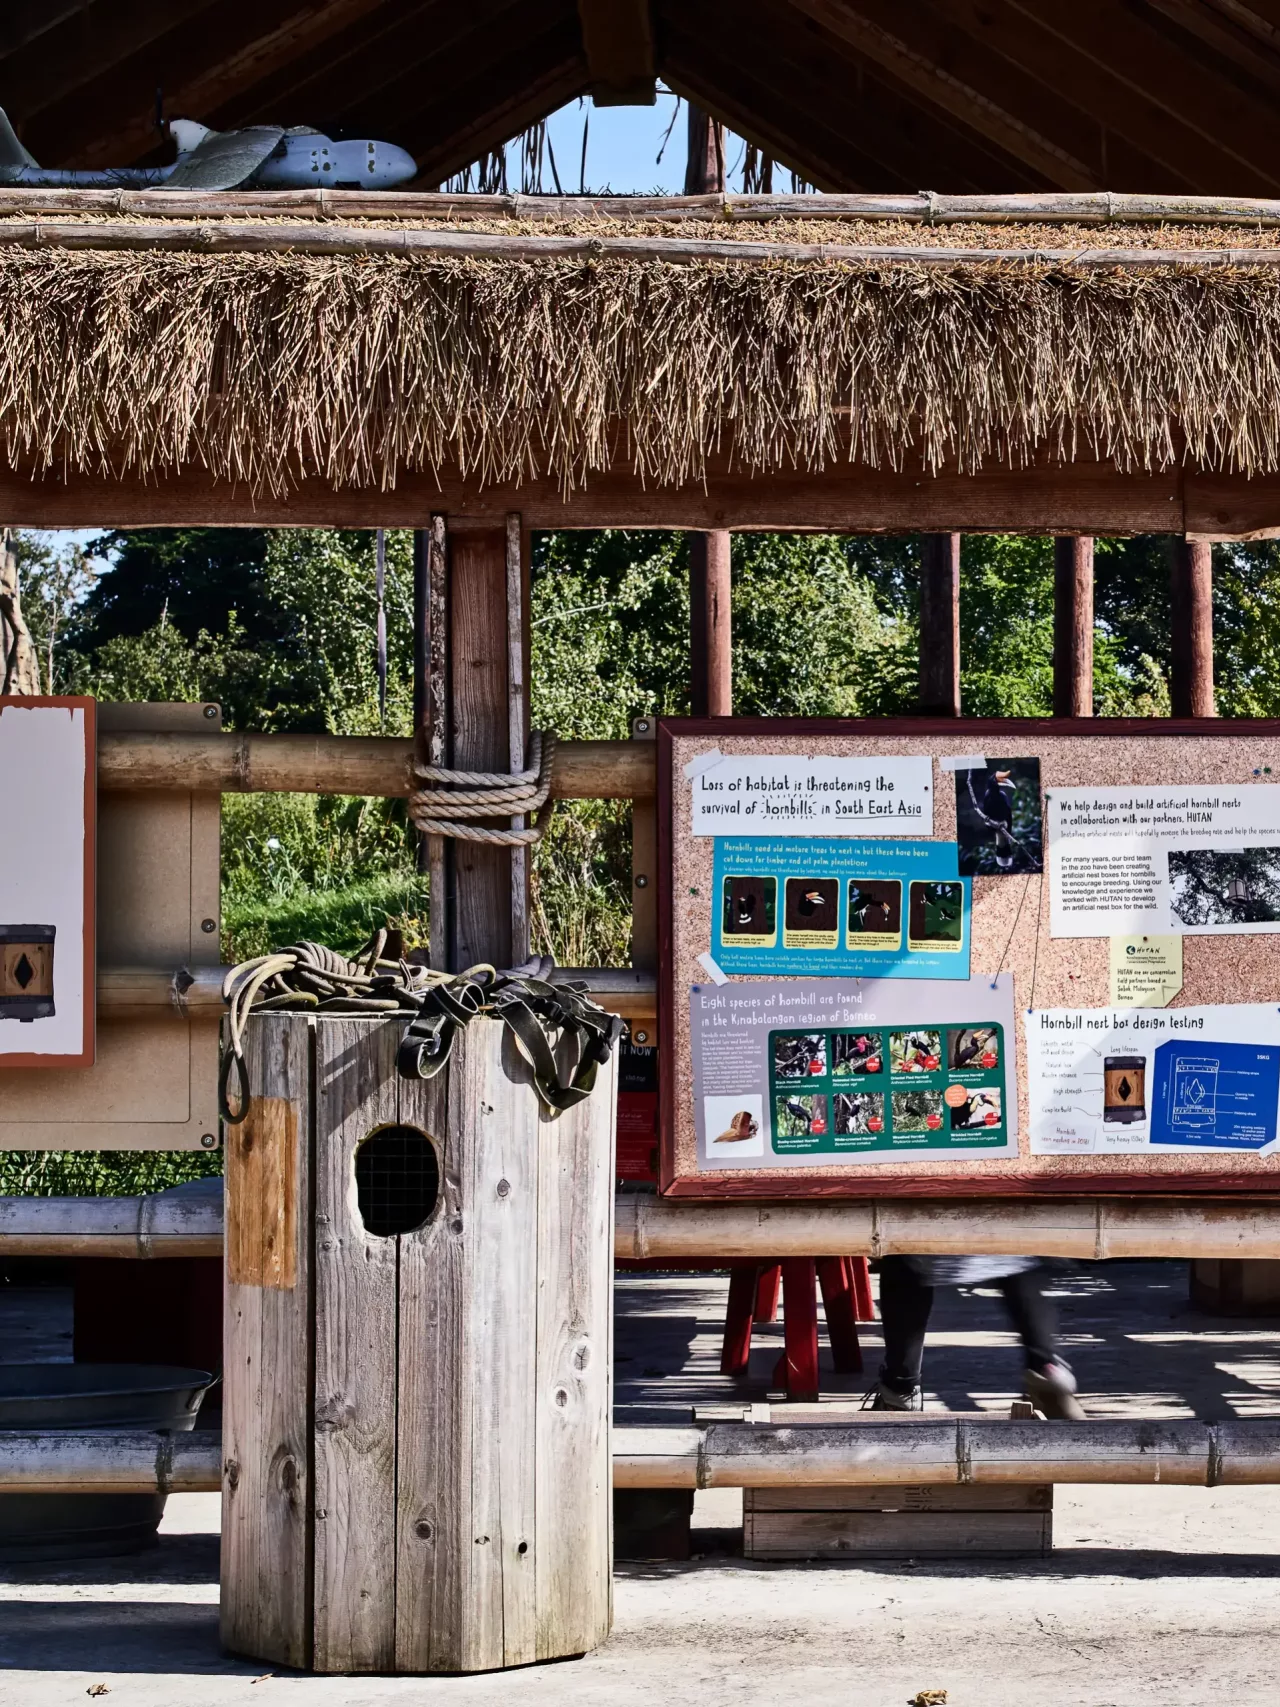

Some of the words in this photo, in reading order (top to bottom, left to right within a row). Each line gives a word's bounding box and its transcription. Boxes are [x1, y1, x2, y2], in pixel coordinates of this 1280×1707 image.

[701, 776, 724, 791] Loss
[729, 776, 742, 791] of
[746, 775, 788, 792] habitat
[794, 780, 801, 791] is
[807, 776, 871, 792] threatening
[876, 776, 894, 791] the
[701, 800, 740, 815] survival
[746, 800, 758, 815] of
[765, 798, 813, 815] hornbills
[822, 804, 830, 814] in
[835, 800, 863, 814] South
[869, 800, 893, 814] East
[898, 800, 921, 814] Asia
[1060, 801, 1071, 811] We
[1075, 800, 1090, 812] help
[1093, 800, 1117, 811] design
[1120, 800, 1132, 809] and
[1136, 799, 1153, 809] build
[1156, 799, 1189, 809] artificial
[1192, 798, 1219, 808] hornbill
[1222, 798, 1241, 808] nests
[1070, 814, 1120, 825] collaboration
[1122, 814, 1137, 823] with
[1187, 812, 1212, 822] HUTAN
[1190, 828, 1211, 836] breeding
[1235, 827, 1247, 835] help
[724, 842, 752, 852] Hornbills
[863, 846, 873, 855] but
[876, 847, 894, 856] these
[701, 995, 726, 1009] Eight
[730, 997, 761, 1010] species
[764, 996, 776, 1006] of
[779, 992, 816, 1006] hornbill
[837, 992, 862, 1004] found
[702, 1019, 709, 1027] in
[713, 1013, 727, 1027] the
[799, 1014, 826, 1024] region
[830, 1011, 840, 1022] of
[843, 1008, 877, 1022] Borneo
[1041, 1014, 1082, 1030] Hornbill
[1087, 1018, 1109, 1029] nest
[1113, 1014, 1129, 1029] box
[1133, 1015, 1165, 1030] design
[1170, 1015, 1204, 1029] testing
[1122, 1045, 1139, 1054] lifespan
